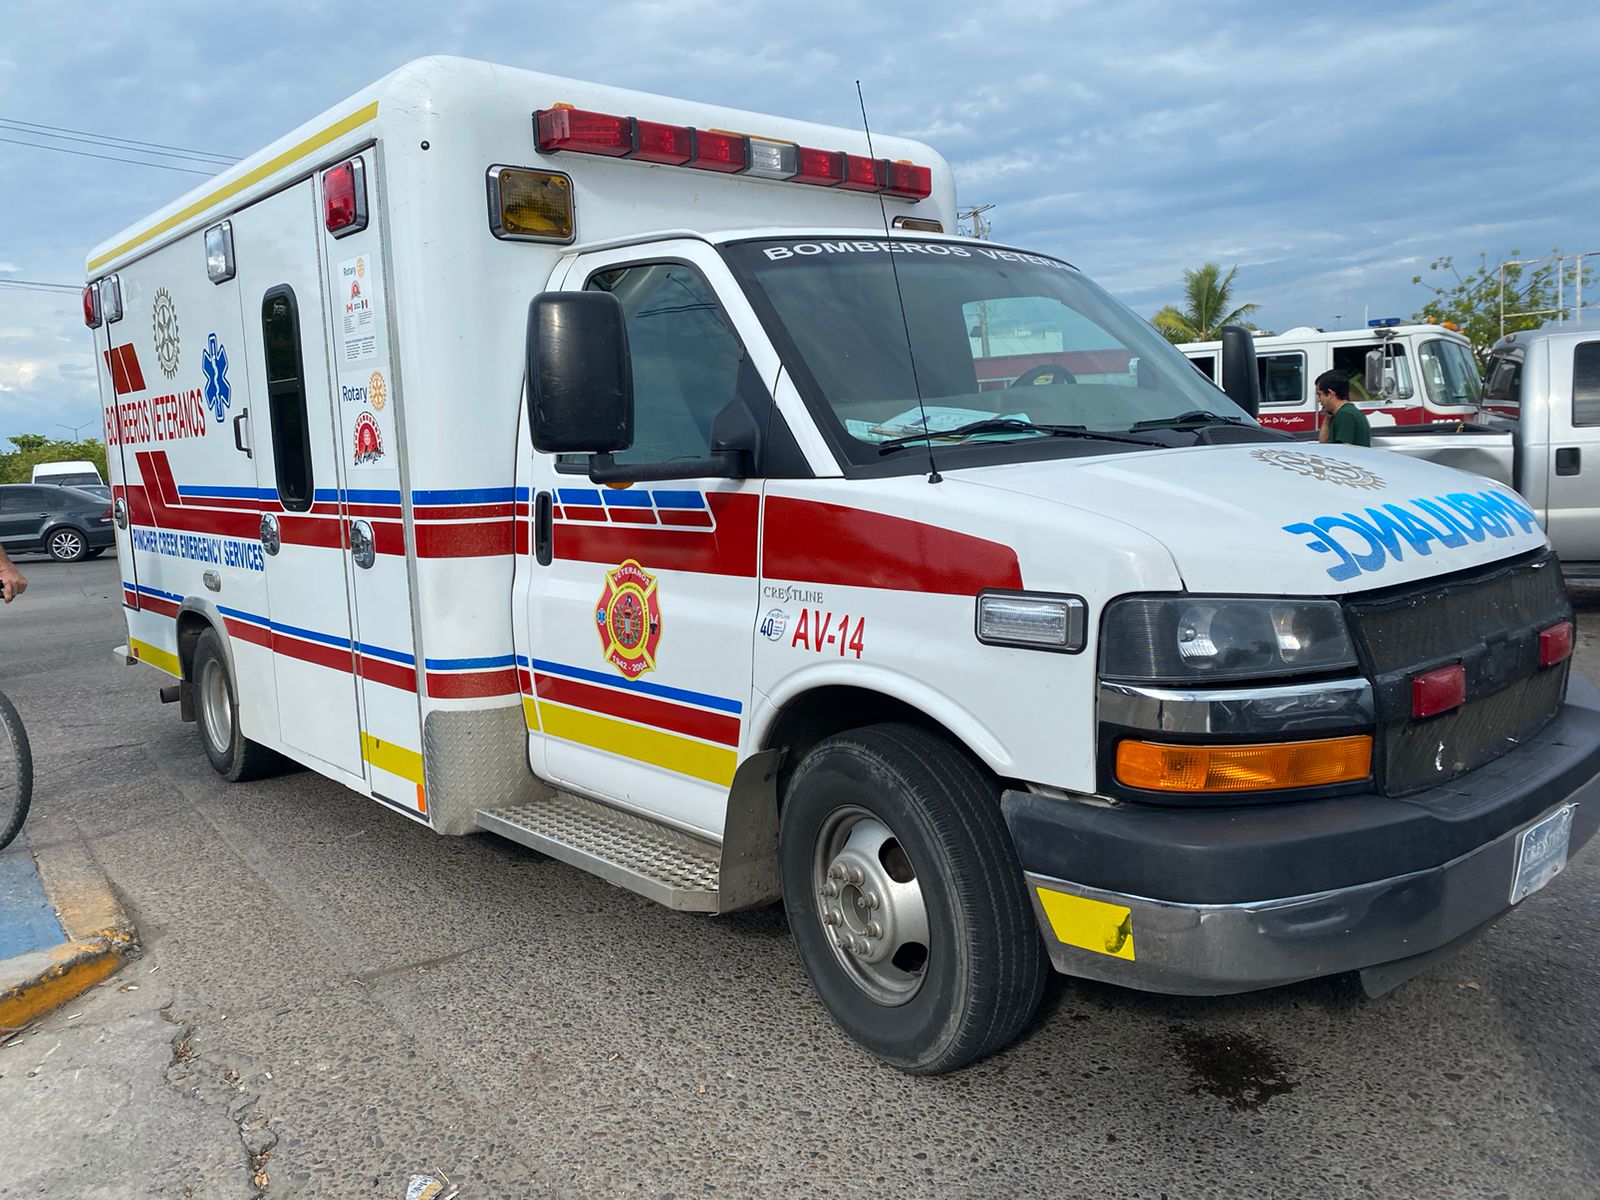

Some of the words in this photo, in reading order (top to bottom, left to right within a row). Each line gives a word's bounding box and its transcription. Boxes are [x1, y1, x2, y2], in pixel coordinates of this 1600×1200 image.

[763, 241, 971, 261] BOMBEROS
[342, 385, 367, 403] Rotary
[105, 399, 150, 446] BOMBEROS
[149, 388, 205, 441] VETERANOS
[133, 529, 160, 554] PINCHER
[158, 531, 181, 557] CREEK
[180, 534, 222, 564] EMERGENCY
[224, 540, 265, 572] SERVICES
[613, 566, 651, 586] VETERANOS
[763, 585, 824, 604] CRESTLINE
[760, 617, 774, 637] 40
[791, 608, 866, 660] AV-14
[612, 655, 628, 670] 1942
[631, 661, 648, 672] 2004
